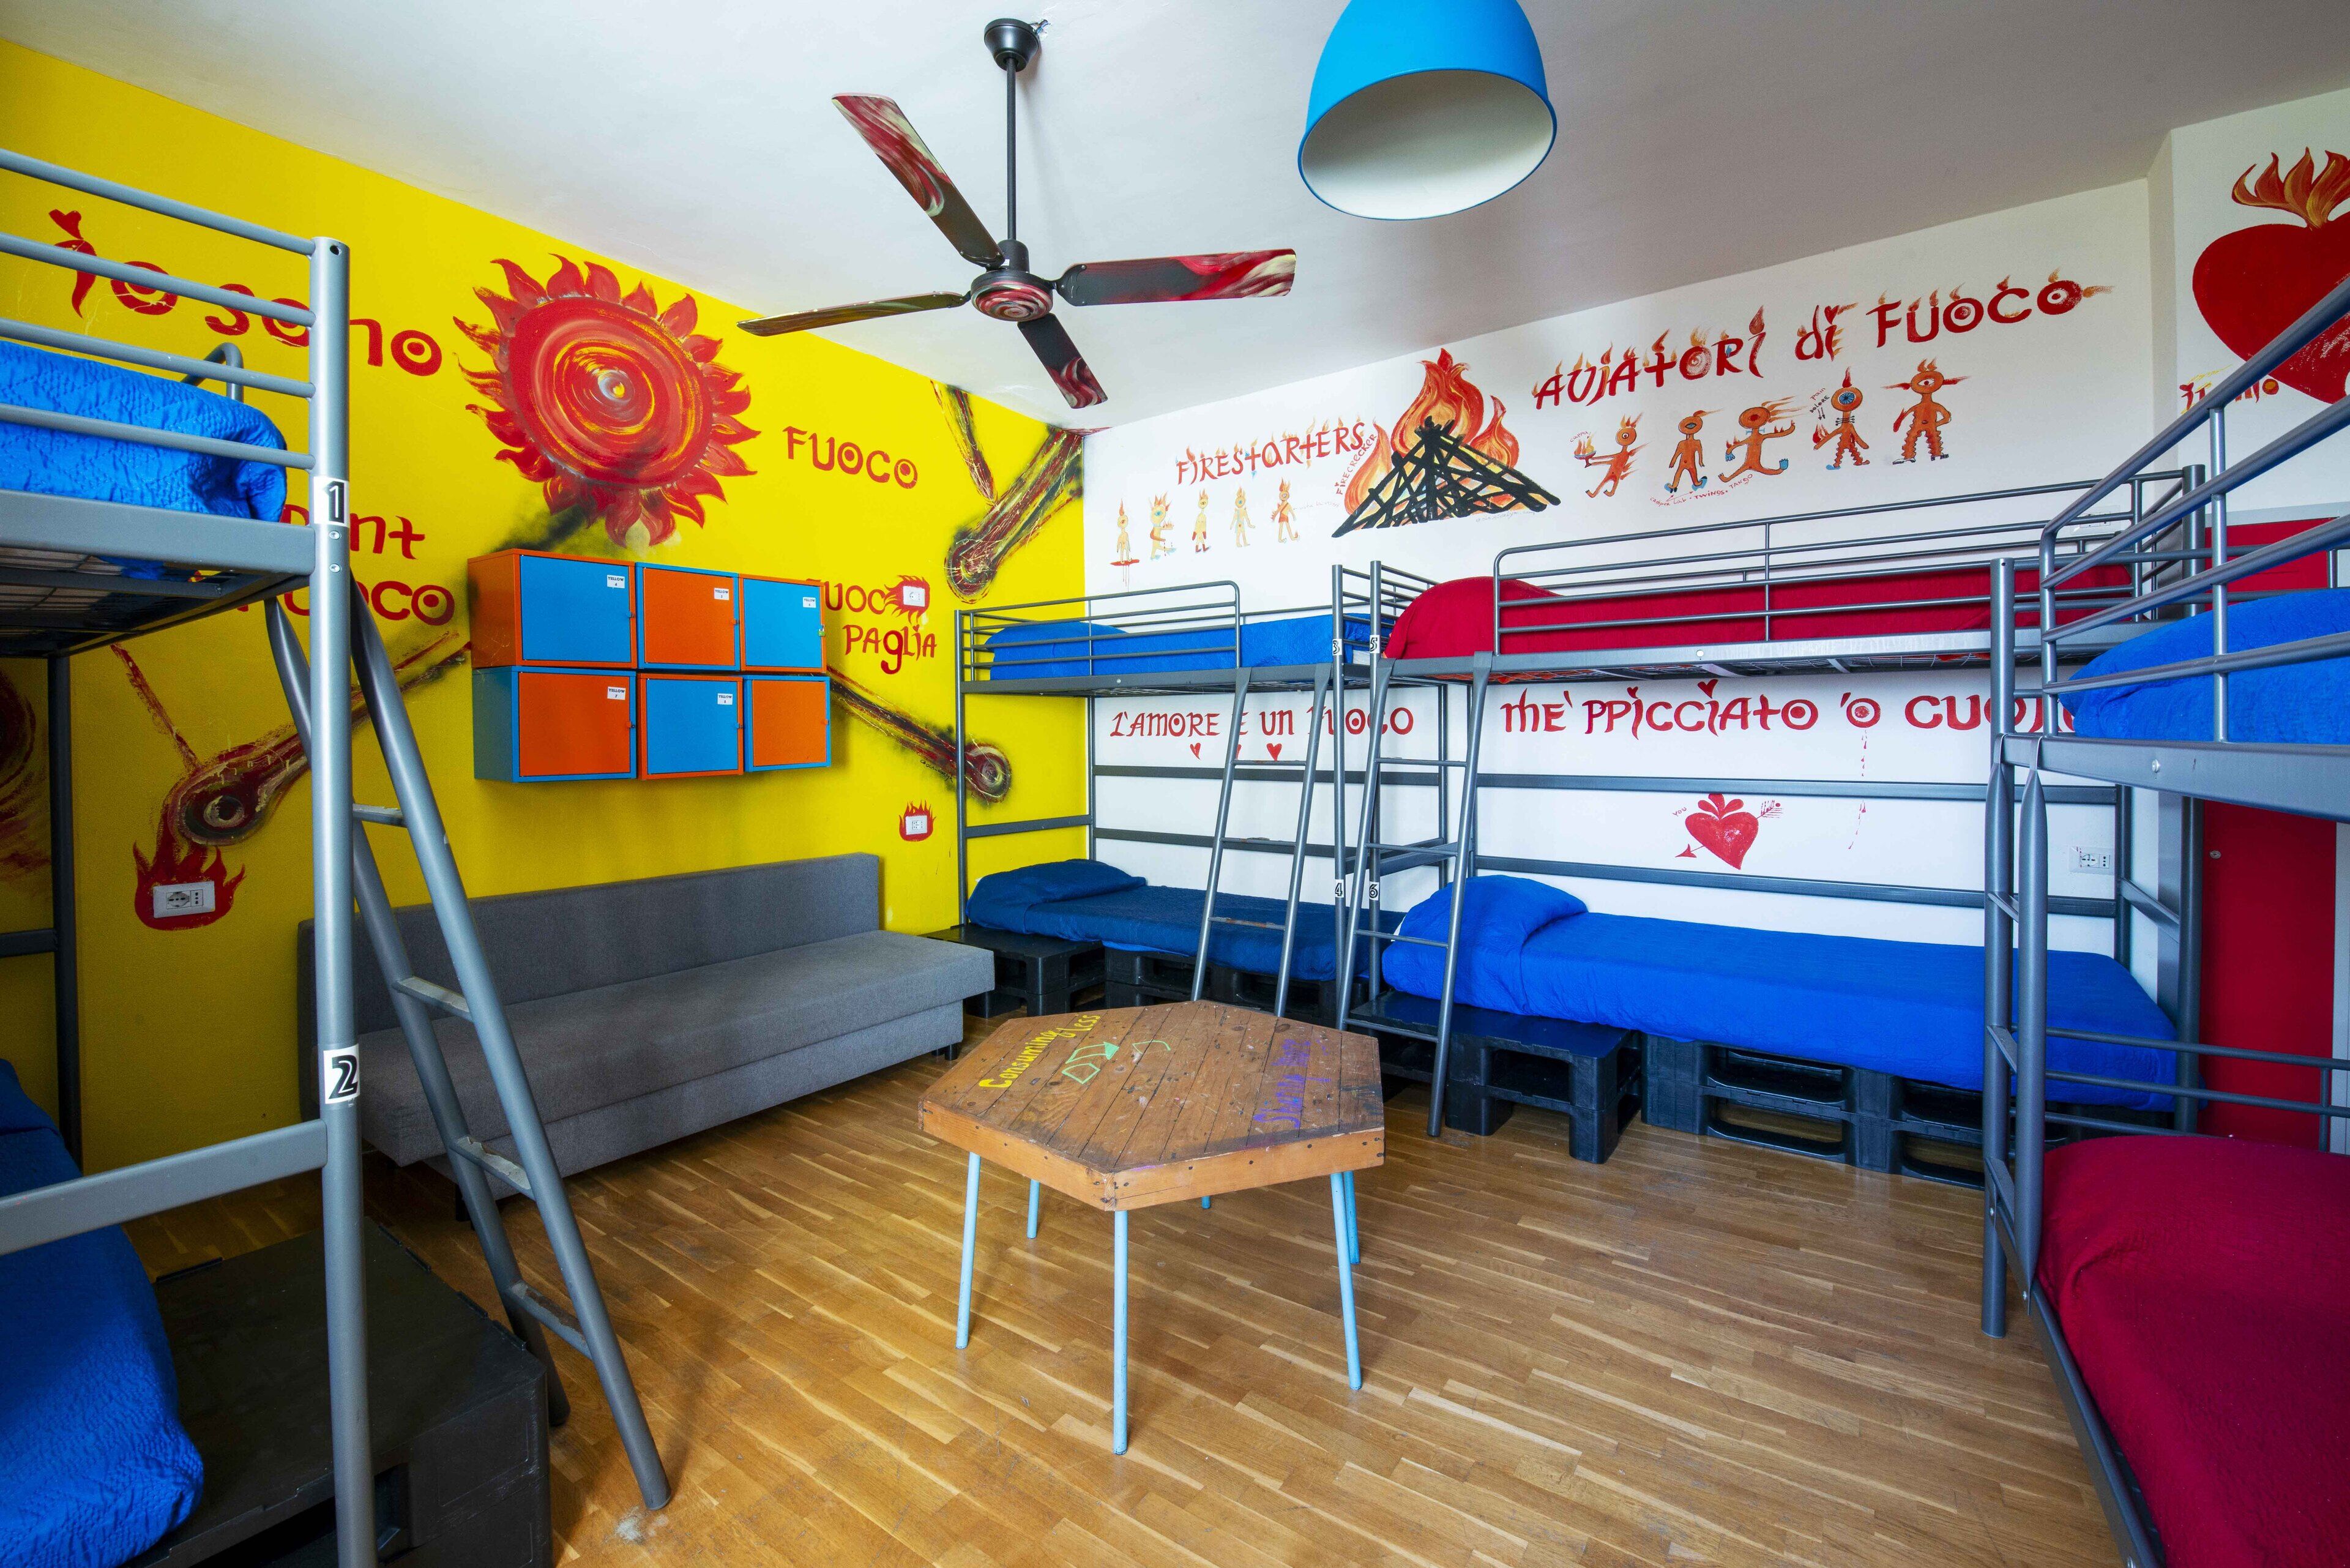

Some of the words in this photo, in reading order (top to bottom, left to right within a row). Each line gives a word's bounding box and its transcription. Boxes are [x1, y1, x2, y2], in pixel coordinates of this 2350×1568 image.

[1866, 280, 2082, 348] FUOCO
[783, 426, 918, 489] FUOCO
[324, 481, 345, 523] 1
[1333, 640, 1340, 655] 3
[1370, 637, 1378, 652] 5
[1335, 882, 1343, 897] 4
[1369, 883, 1378, 898] 6
[328, 1054, 359, 1100] 2
[979, 1030, 1076, 1088] Consuming
